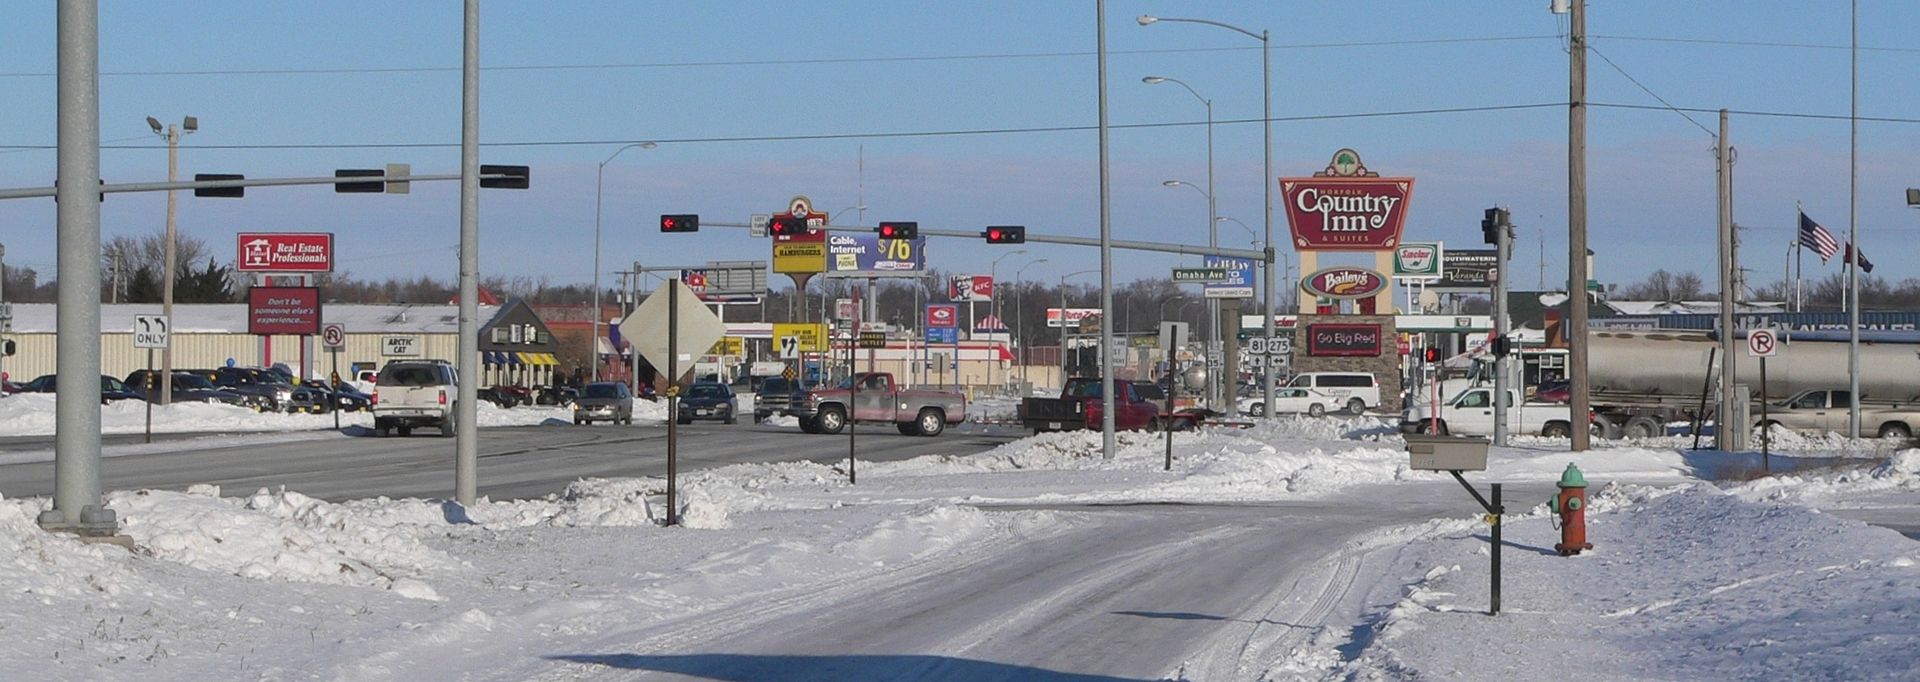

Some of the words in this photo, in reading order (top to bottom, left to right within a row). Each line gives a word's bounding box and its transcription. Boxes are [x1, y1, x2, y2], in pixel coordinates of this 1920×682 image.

[1297, 188, 1400, 229] Country
[1322, 202, 1368, 231] Inn
[830, 236, 857, 246] Cable,
[277, 243, 297, 253] Real
[299, 243, 324, 253] Estate
[830, 246, 866, 254] Internet
[272, 253, 327, 263] Professionals
[1176, 271, 1205, 279] Omaha
[1208, 271, 1223, 279] Ave
[974, 281, 990, 291] KFC
[137, 333, 165, 344] ONLY
[1317, 333, 1332, 343] Go
[1334, 333, 1352, 346] Big
[1354, 333, 1376, 343] Red
[1252, 340, 1263, 351] 81
[1269, 340, 1289, 351] 275
